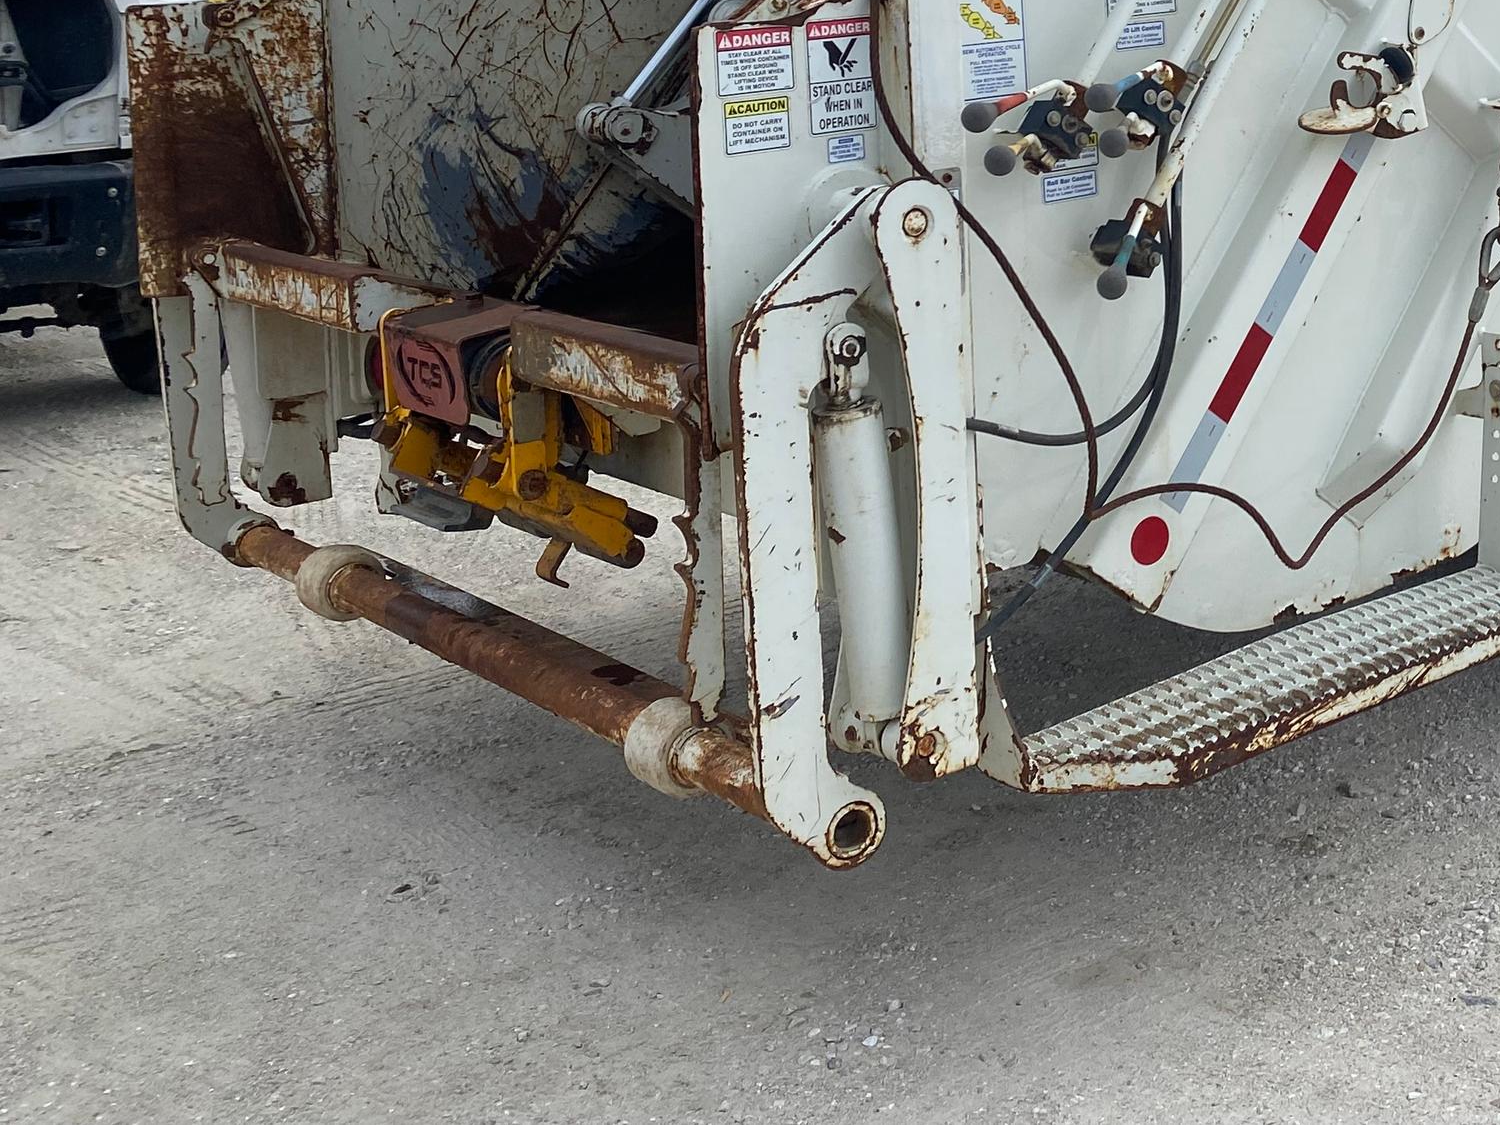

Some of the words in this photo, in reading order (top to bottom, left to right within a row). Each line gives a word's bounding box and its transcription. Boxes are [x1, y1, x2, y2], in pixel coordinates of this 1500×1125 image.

[821, 21, 870, 35] DANGER
[732, 31, 790, 47] DANGER
[813, 84, 841, 98] STAND
[844, 80, 872, 94] CLEAR
[737, 100, 785, 114] CAUTION
[825, 98, 851, 112] WHEN
[854, 98, 862, 109] IN
[820, 113, 869, 130] OPERATION
[733, 128, 771, 137] CONTAINER
[1072, 174, 1092, 182] Control
